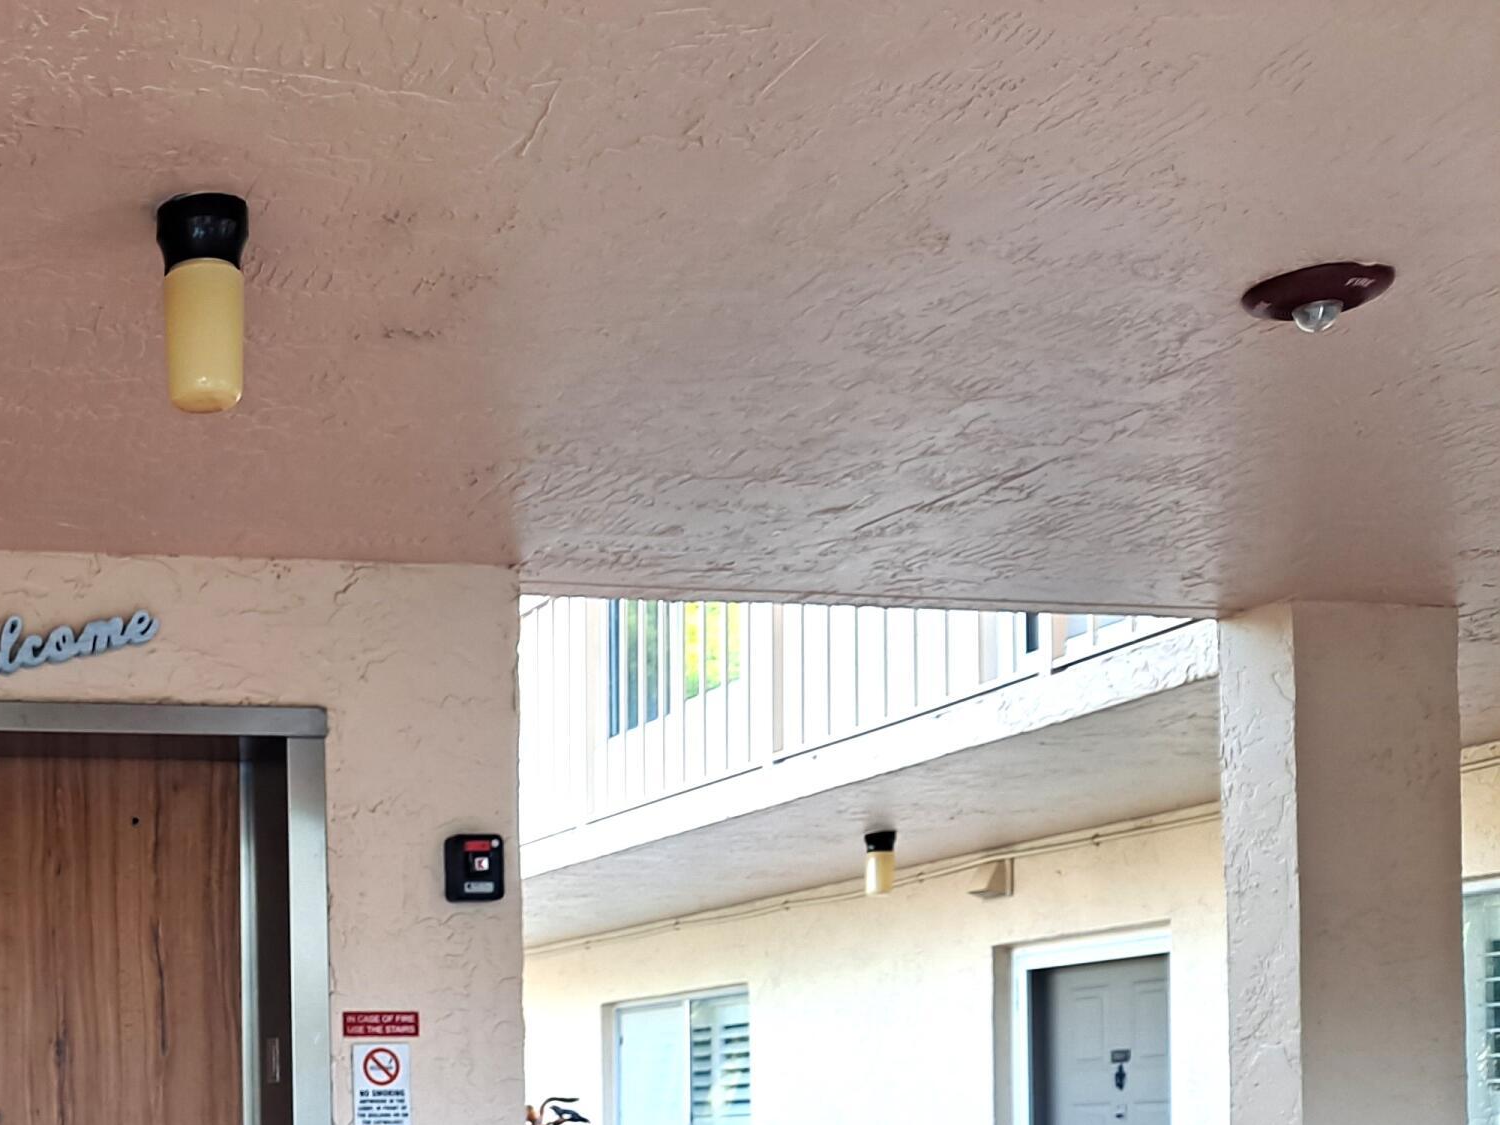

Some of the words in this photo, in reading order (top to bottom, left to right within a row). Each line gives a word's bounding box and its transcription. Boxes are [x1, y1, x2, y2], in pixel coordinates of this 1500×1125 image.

[357, 1014, 380, 1023] CASE
[381, 1014, 394, 1023] OF
[395, 1014, 415, 1023] FIRE
[385, 1025, 416, 1034] STAIRS
